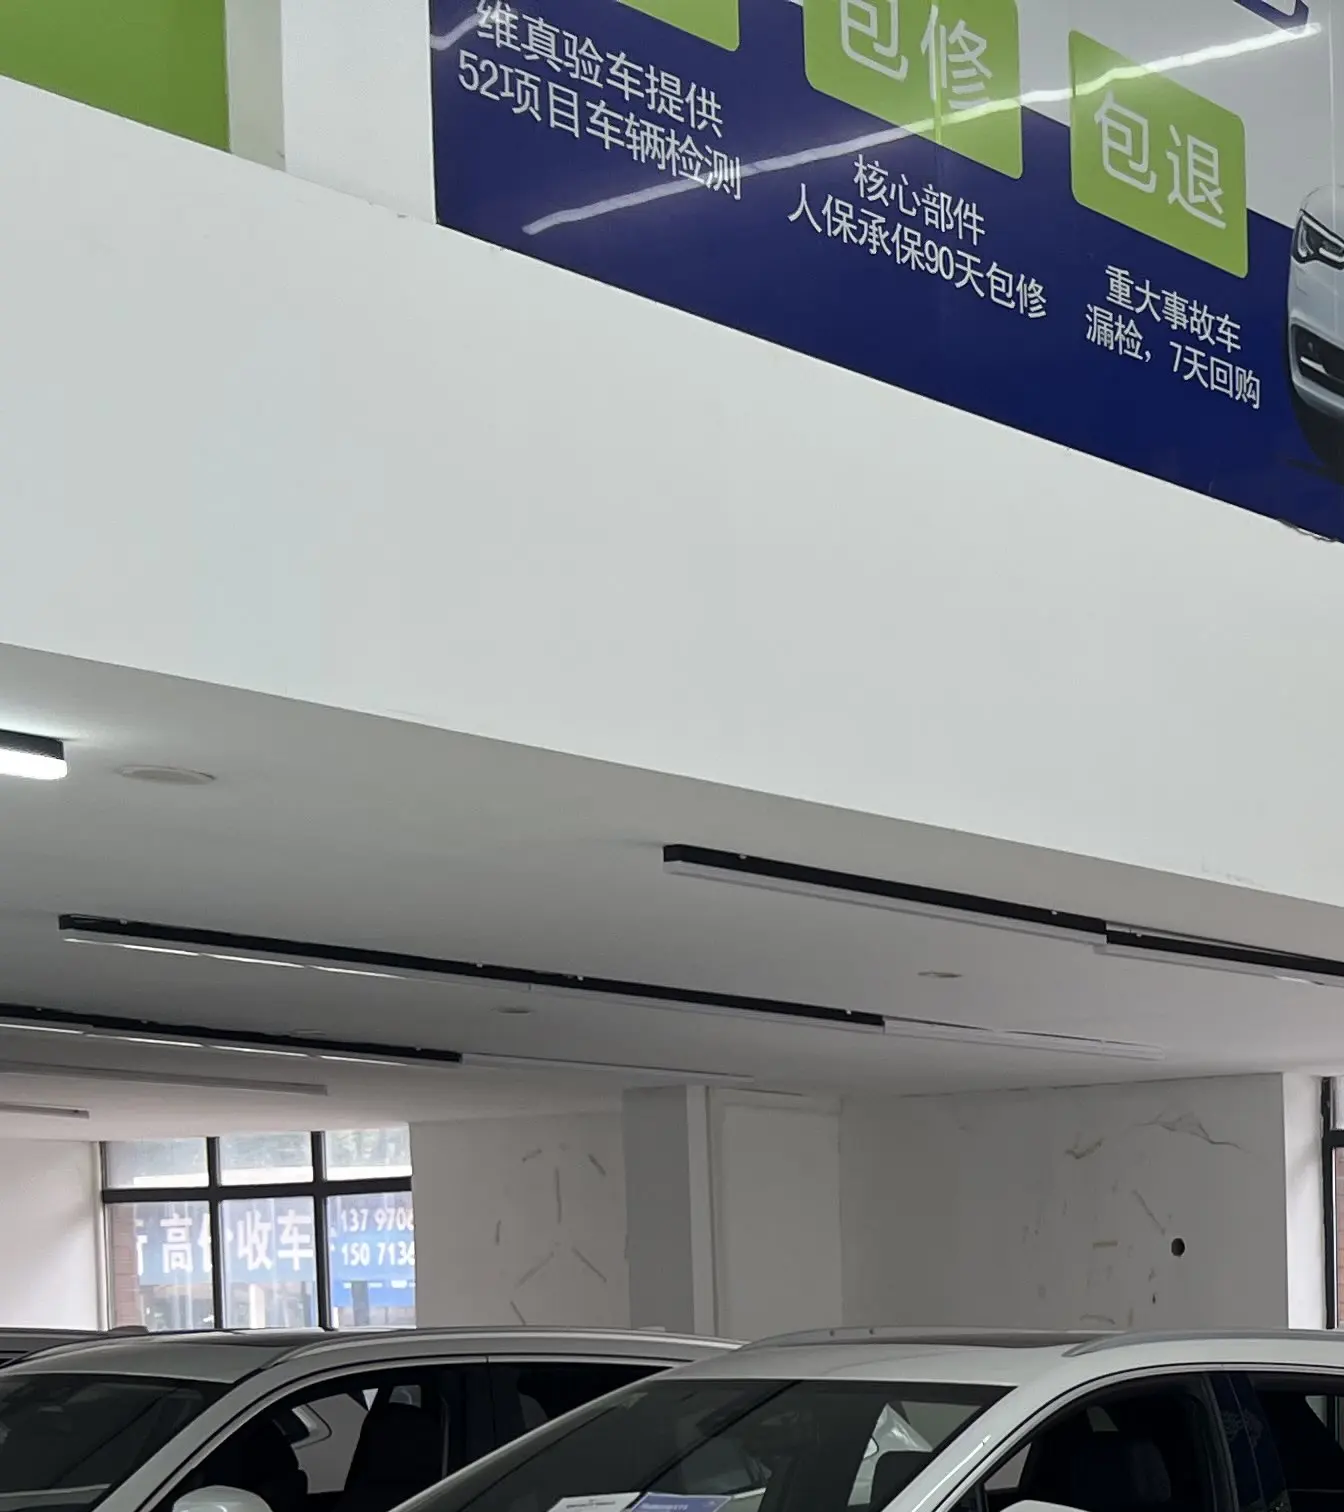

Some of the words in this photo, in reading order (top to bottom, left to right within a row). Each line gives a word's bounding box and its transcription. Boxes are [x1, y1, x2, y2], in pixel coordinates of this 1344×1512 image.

[476, 0, 723, 138] 维真验车提供
[839, 0, 994, 112] 包修
[458, 48, 741, 201] 52项目车辆检测
[1094, 90, 1227, 230] 包退
[787, 182, 1048, 321] 人保承保90天包修
[853, 153, 987, 246] 核心部件
[1104, 264, 1242, 354] 重大事故车
[340, 1208, 369, 1232] 137
[341, 1241, 370, 1266] 150
